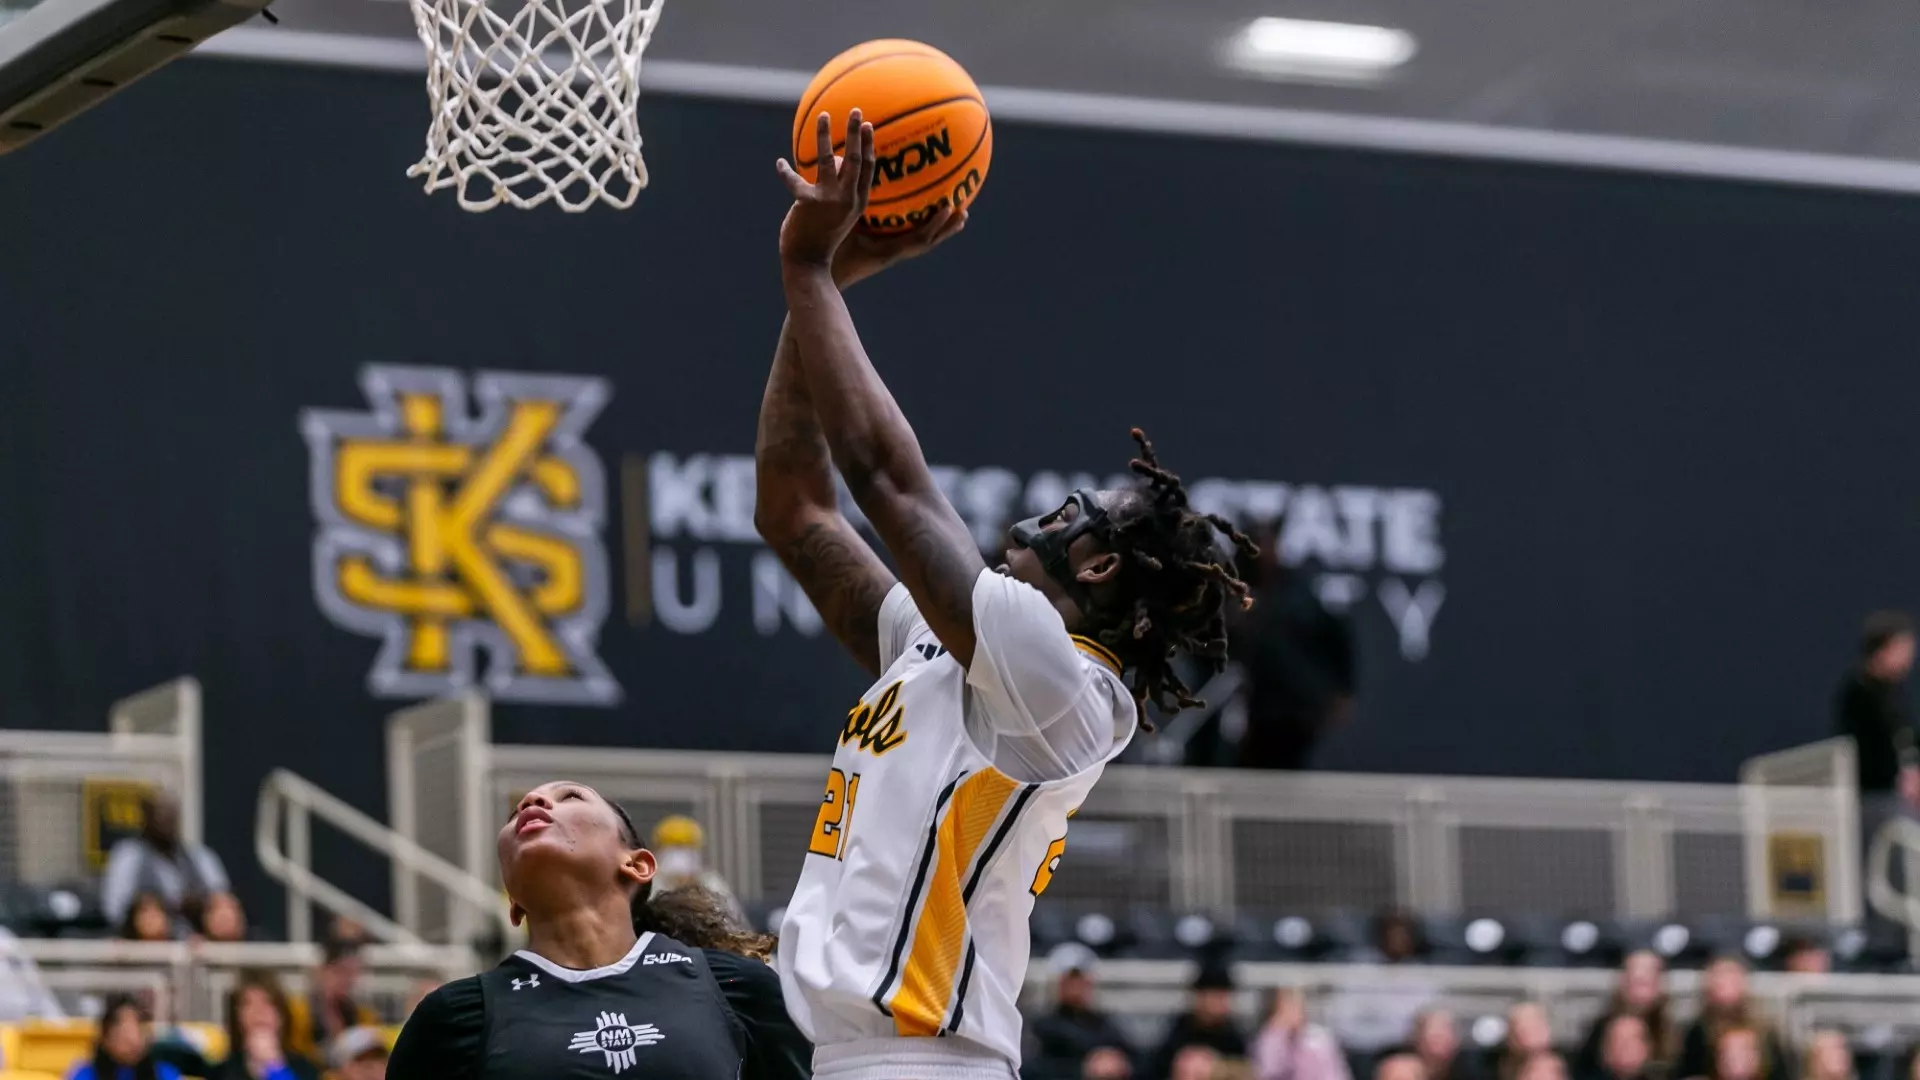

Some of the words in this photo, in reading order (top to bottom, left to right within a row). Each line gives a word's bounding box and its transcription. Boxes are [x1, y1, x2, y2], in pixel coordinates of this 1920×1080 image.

[808, 767, 861, 863] 21
[600, 1028, 631, 1041] NM
[601, 1037, 633, 1048] STATE
